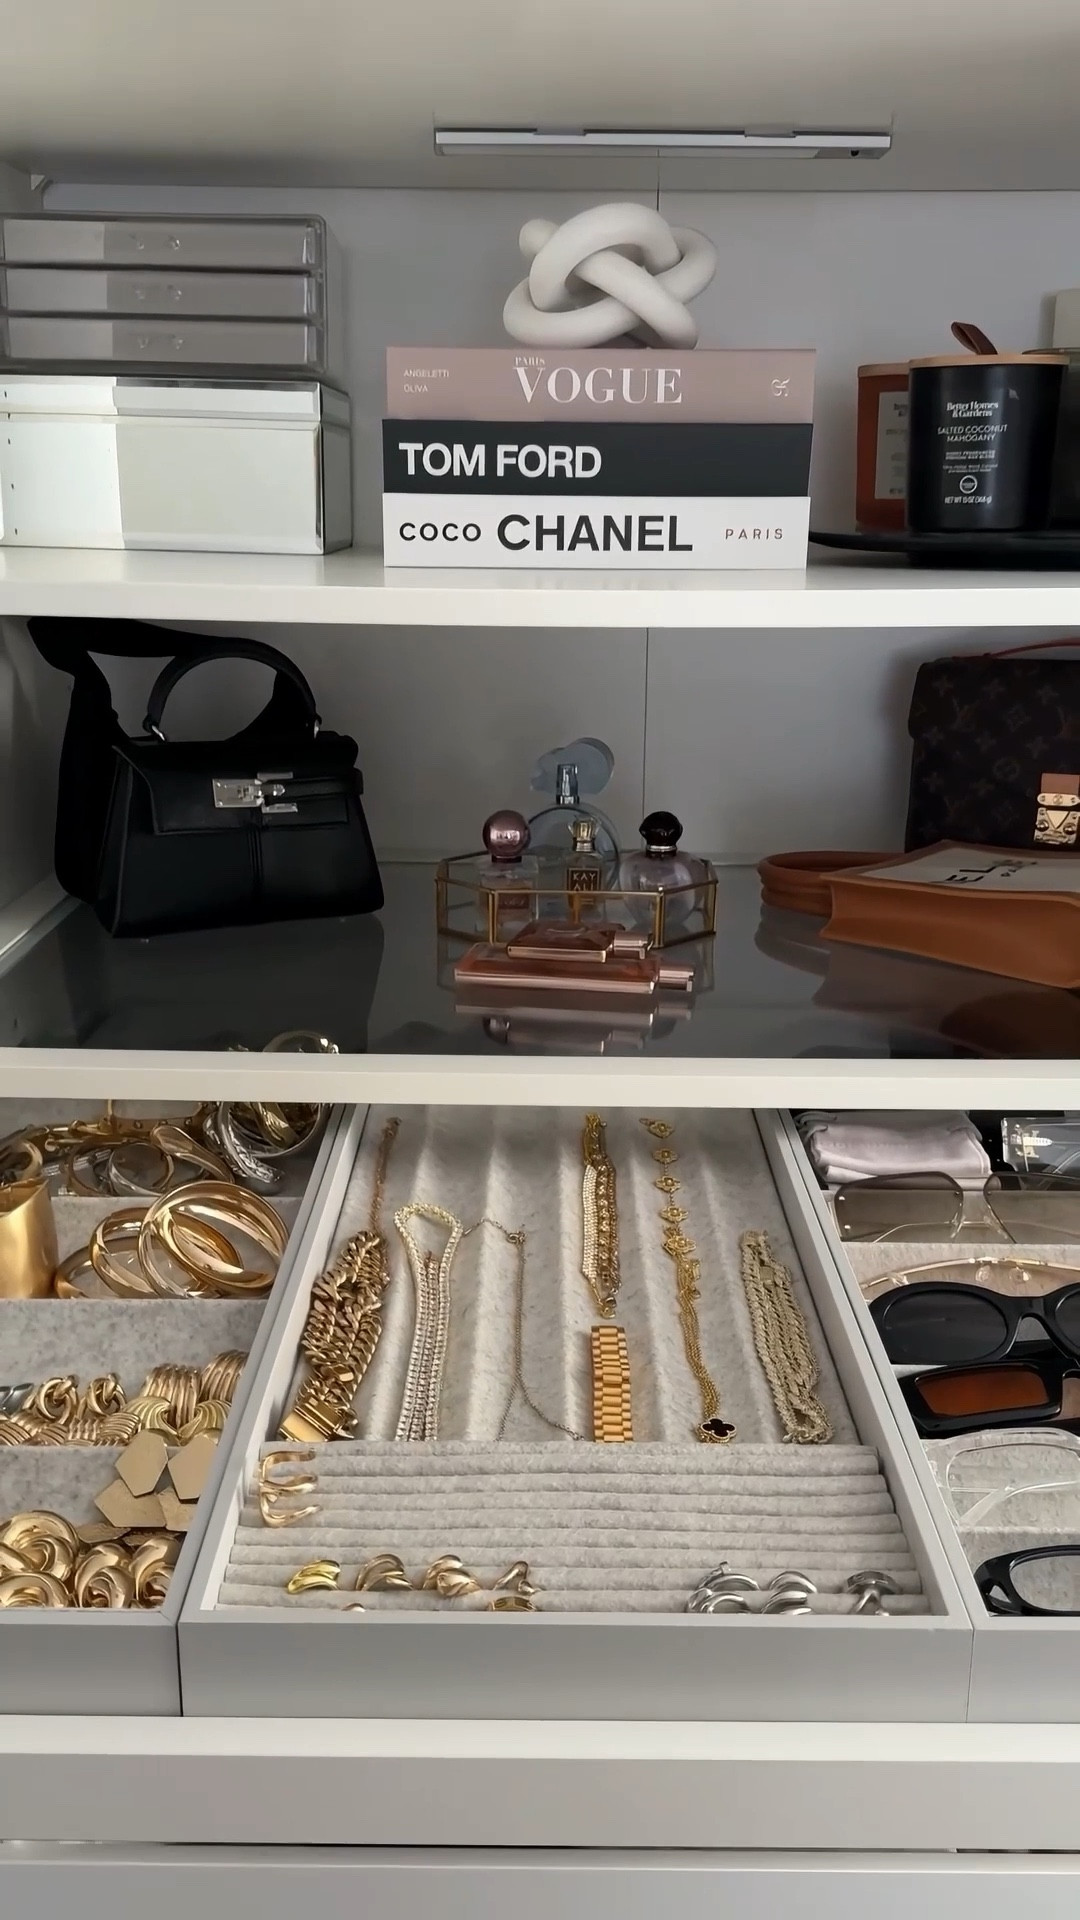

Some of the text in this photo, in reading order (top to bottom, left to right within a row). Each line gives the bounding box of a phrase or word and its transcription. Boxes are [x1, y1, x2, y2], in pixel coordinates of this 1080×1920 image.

[515, 356, 546, 366] PARIS
[403, 368, 450, 378] ANGELETTI
[403, 383, 424, 393] OLIVA
[512, 366, 683, 404] VOGUE
[937, 424, 1008, 435] SALTED COCONUT
[946, 433, 996, 442] MAHOGANY
[398, 442, 602, 479] TOM FORD
[399, 513, 784, 552] COCO CHANEL PARIS
[573, 872, 596, 881] KAY
